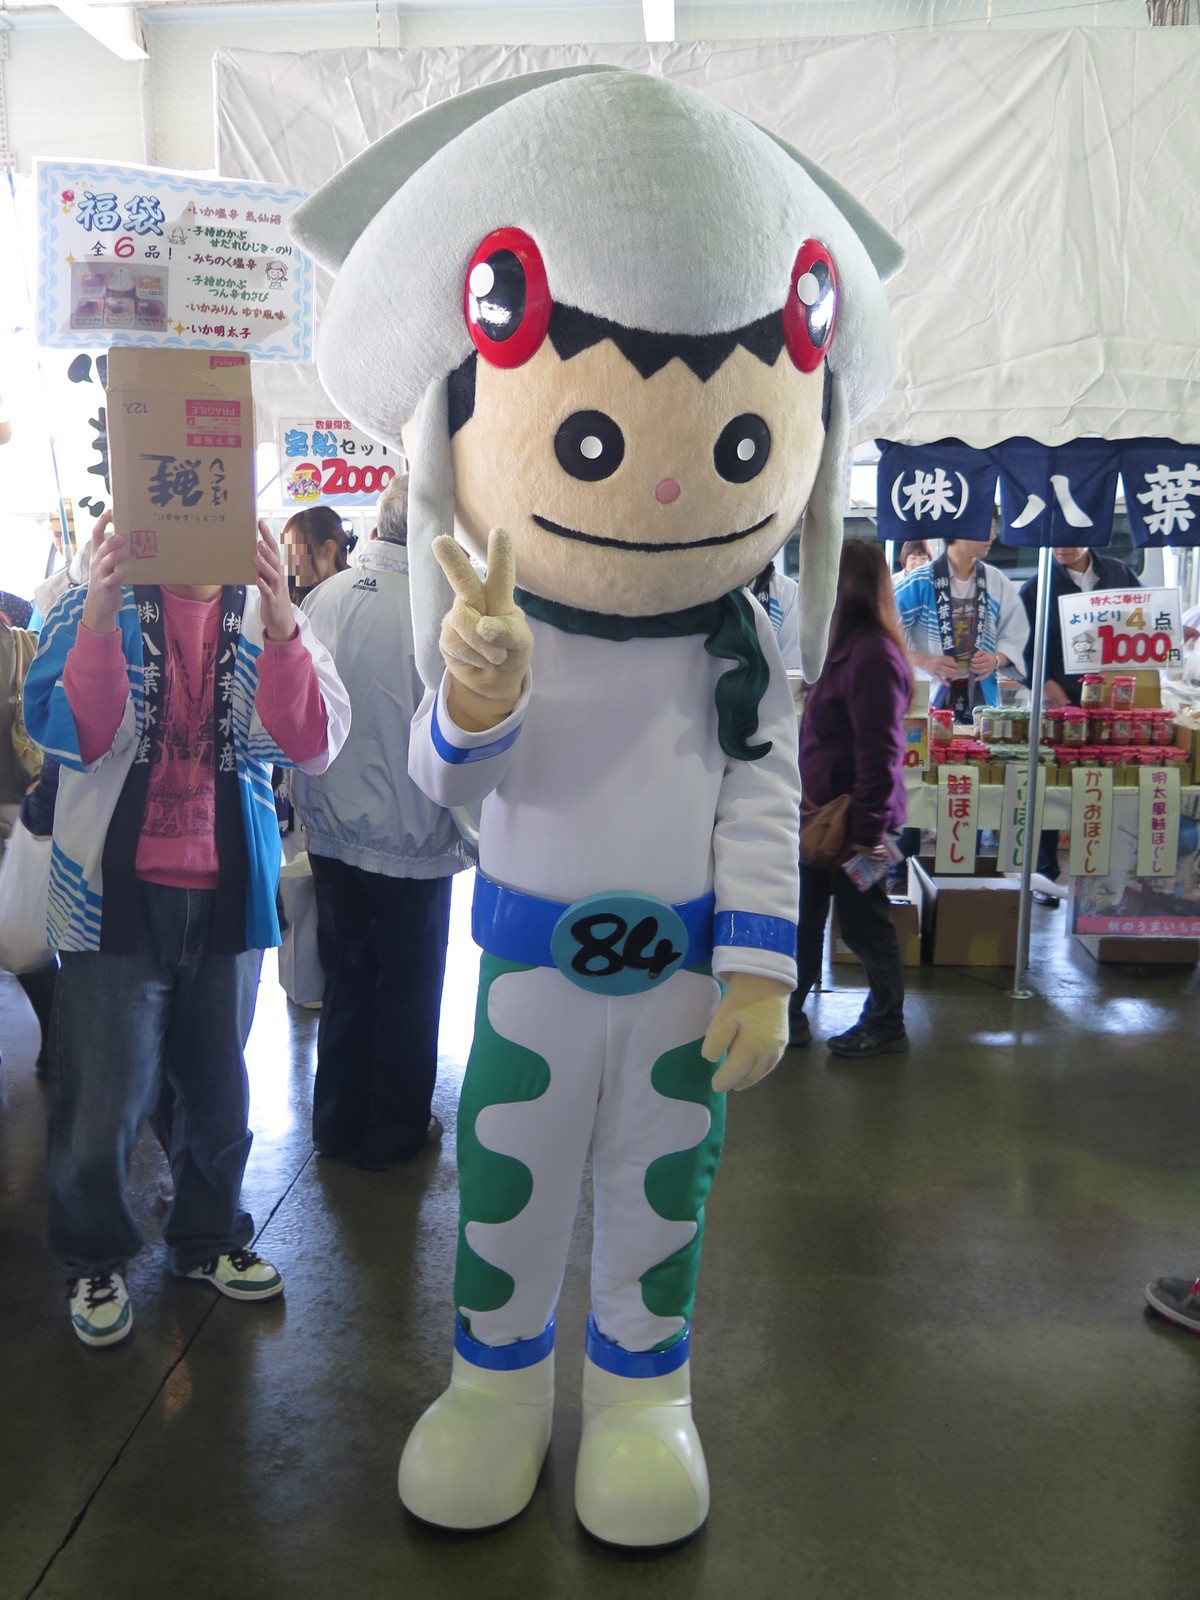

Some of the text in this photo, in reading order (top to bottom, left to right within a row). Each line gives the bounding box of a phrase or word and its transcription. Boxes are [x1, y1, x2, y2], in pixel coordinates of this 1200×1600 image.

[76, 191, 165, 237] 福袋
[191, 405, 236, 416] FRAGILE
[315, 420, 352, 430] 数量限定
[322, 458, 396, 495] 2000
[947, 773, 972, 864] 鮭ほぐし
[1083, 770, 1102, 874] かつおほぐし
[570, 912, 682, 980] 84
